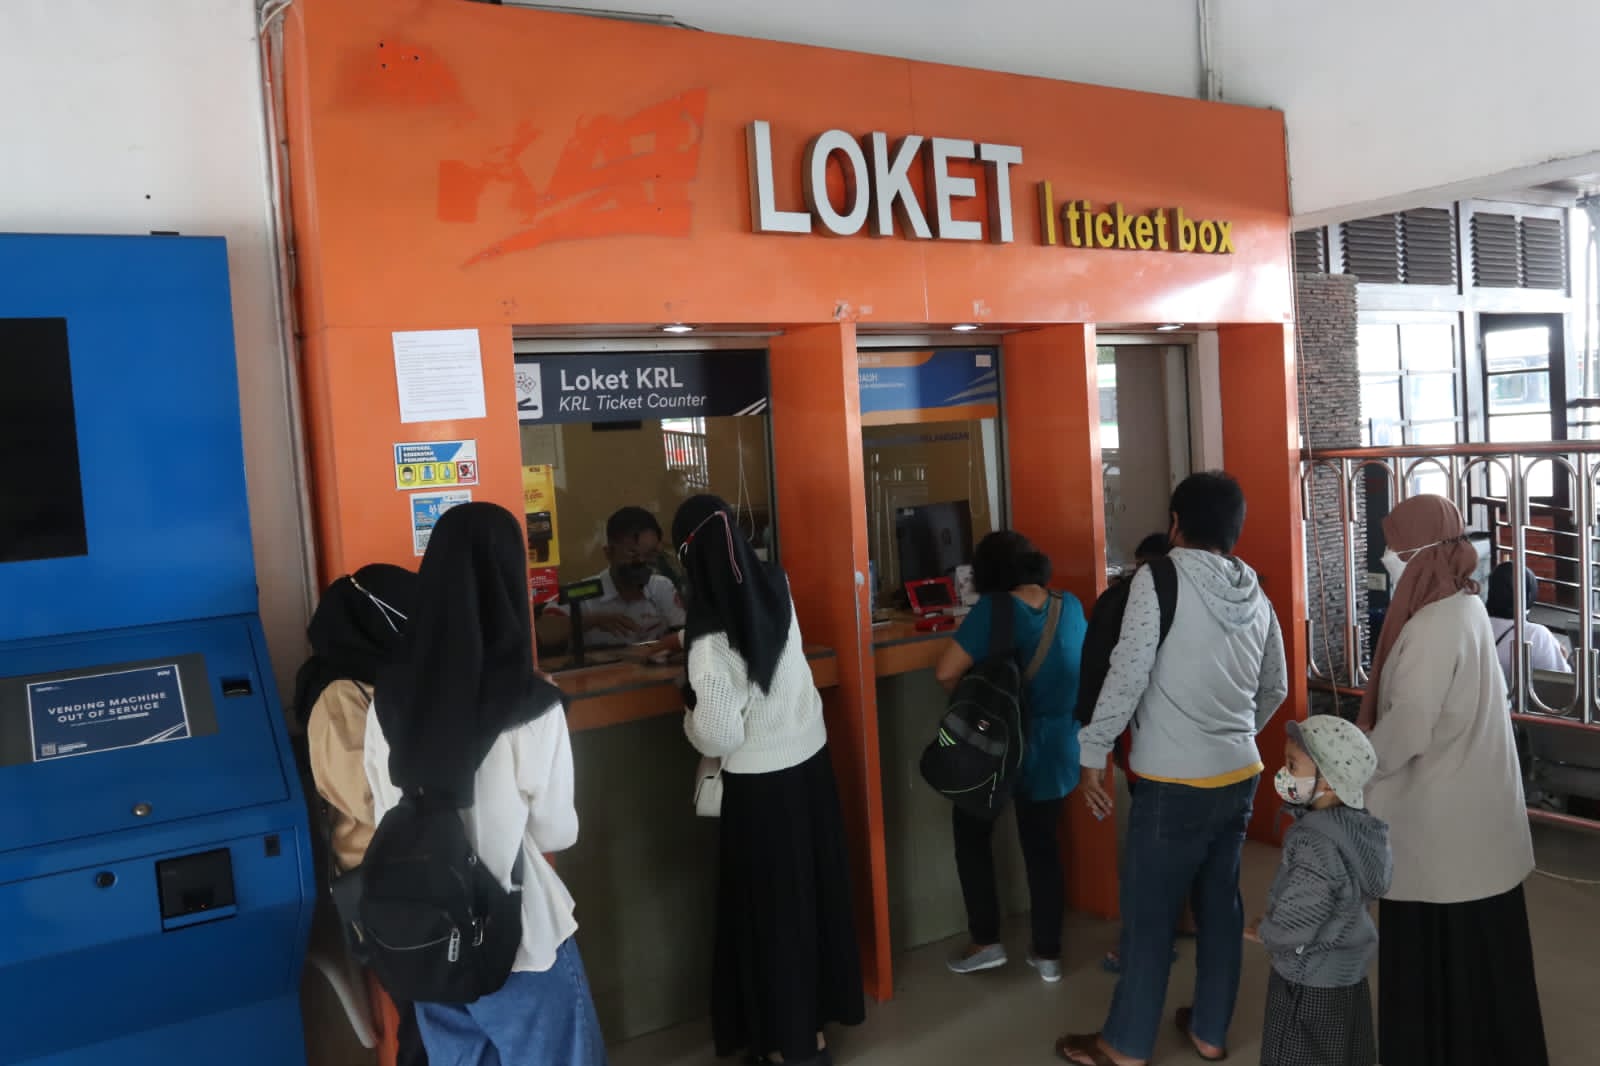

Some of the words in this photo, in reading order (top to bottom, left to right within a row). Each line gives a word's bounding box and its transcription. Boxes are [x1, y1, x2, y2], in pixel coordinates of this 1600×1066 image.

[748, 119, 1023, 243] LOKET
[1064, 201, 1170, 250] ticket
[1176, 206, 1235, 254] box
[560, 368, 629, 391] Loket
[636, 367, 683, 389] KRL
[559, 396, 591, 412] KRL
[596, 394, 643, 410] Ticket
[647, 392, 707, 408] Counter
[48, 701, 105, 715] VENDING
[109, 691, 167, 707] MACHINE
[57, 713, 83, 723] OUT
[88, 710, 105, 719] OF
[108, 701, 160, 715] SERVICE
